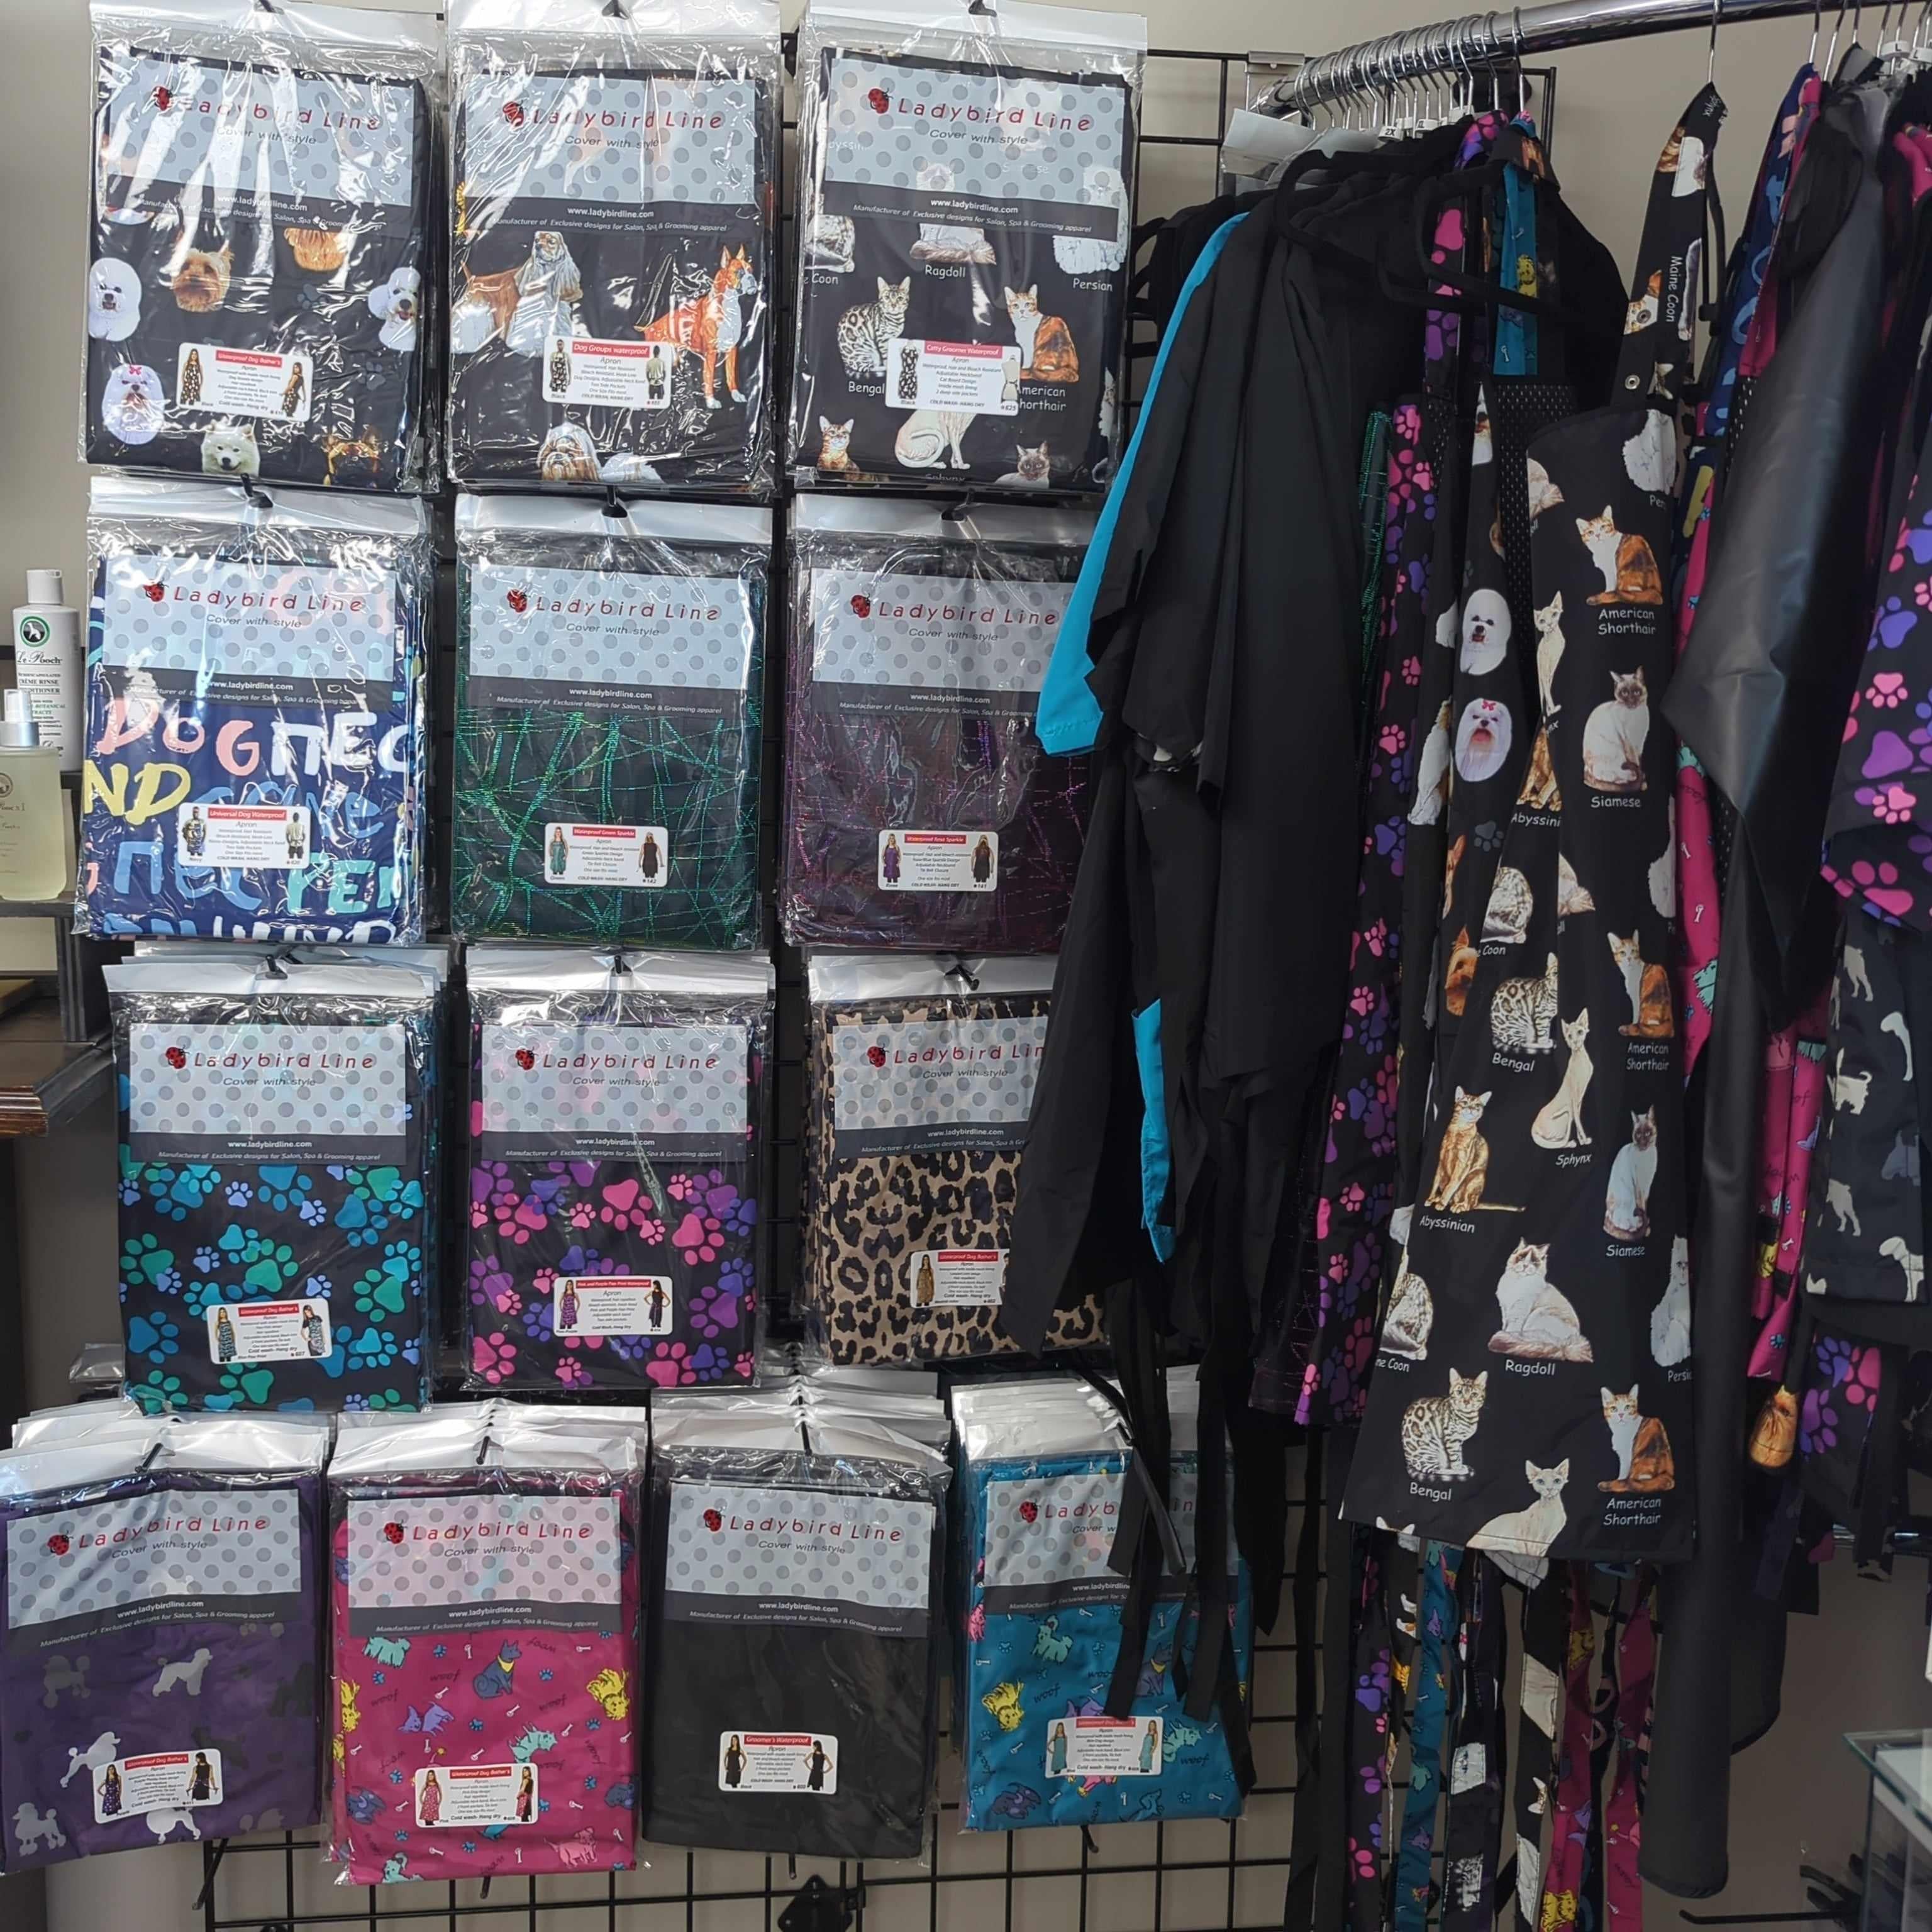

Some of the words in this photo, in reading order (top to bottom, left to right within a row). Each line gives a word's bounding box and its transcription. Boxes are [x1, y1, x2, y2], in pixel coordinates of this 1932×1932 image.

[1913, 50, 1918, 58] L
[324, 113, 379, 130] Line
[666, 111, 723, 128] Line
[899, 98, 1024, 123] Ladybird
[1035, 111, 1091, 131] Line
[216, 126, 253, 137] Cover
[287, 134, 316, 144] style
[930, 130, 967, 140] Cover
[971, 133, 995, 144] with
[1000, 136, 1028, 146] style
[565, 135, 601, 145] Cover
[607, 138, 631, 147] with
[636, 138, 659, 150] style
[567, 207, 654, 218] www.ladybirdline.com
[931, 198, 1019, 214] www.ladybirdline.com
[853, 204, 901, 216] Manufacturer
[913, 210, 945, 219] Exclusive
[946, 213, 973, 223] designs
[975, 215, 985, 223] for
[986, 218, 1007, 226] Salon,
[1009, 219, 1021, 227] Spa
[1031, 220, 1063, 232] Grooming
[1065, 224, 1092, 233] apparel
[925, 265, 966, 277] Ragdoll
[1670, 255, 1684, 293] Maine
[811, 274, 838, 285] Coon
[1073, 278, 1113, 291] Persian
[1666, 293, 1679, 323] Coon
[574, 344, 587, 352] Dog
[589, 345, 612, 353] Groups
[848, 381, 884, 397] Bengal
[1018, 385, 1066, 397] merican
[1020, 399, 1067, 412] horthair
[174, 587, 297, 609] Ladybird
[308, 597, 363, 612] Line
[536, 596, 655, 617] Ladybird
[665, 604, 719, 620] Line
[879, 602, 995, 623] Ladybird
[1005, 609, 1058, 625] Line
[1599, 608, 1655, 621] American
[207, 614, 241, 625] Cover
[246, 617, 269, 626] with
[274, 619, 302, 629] style
[567, 623, 600, 633] Cover
[606, 625, 628, 634] with
[633, 628, 660, 637] style
[909, 628, 942, 638] Cover
[947, 631, 968, 640] with
[972, 633, 999, 641] style
[1597, 622, 1657, 636] Shorthair
[569, 688, 653, 699] www.ladybirdline.com
[910, 693, 991, 704] www.ladybirdline.com
[1591, 796, 1641, 809] Siamese
[1511, 812, 1562, 827] Abyssini
[1482, 945, 1506, 956] Coon
[894, 1045, 1002, 1063] Ladybird
[1012, 1043, 1046, 1058] Lin
[1627, 1043, 1669, 1055] American
[195, 1053, 311, 1068] Ladybird
[321, 1054, 374, 1069] Line
[543, 1054, 655, 1069] Ladybird
[666, 1055, 717, 1070] Line
[1492, 1052, 1535, 1072] Bengal
[1626, 1059, 1670, 1070] Shorthair
[923, 1070, 953, 1079] Cover
[983, 1069, 1008, 1077] style
[264, 1078, 286, 1086] with
[290, 1078, 316, 1087] style
[573, 1077, 605, 1085] Cover
[609, 1077, 631, 1085] with
[635, 1077, 660, 1087] style
[928, 1128, 1004, 1137] www.ladybirdline.com
[228, 1140, 312, 1148] www.ladybirdline.com
[575, 1138, 655, 1146] www.ladybirdline.com
[1555, 1153, 1592, 1167] Sphynx
[1419, 1215, 1475, 1233] Abyssinian
[1606, 1245, 1645, 1257] Siamese
[1387, 1358, 1409, 1372] Coon
[1505, 1359, 1555, 1376] Ragdoll
[1668, 1368, 1691, 1382] Persi
[1409, 1482, 1452, 1501] Bengal
[1046, 1501, 1116, 1518] Ladyb
[1606, 1496, 1661, 1509] American
[1602, 1513, 1661, 1525] Shorthair
[79, 1518, 203, 1549] Ladybird
[213, 1518, 267, 1532] Line
[413, 1523, 528, 1540] Ladybird
[539, 1524, 593, 1539] Line
[730, 1516, 842, 1536] Ladybird
[852, 1525, 902, 1541] Line
[1072, 1525, 1104, 1534] Cover
[112, 1545, 147, 1558] Cover
[152, 1540, 176, 1548] with
[180, 1540, 208, 1550] style
[444, 1547, 479, 1557] Cover
[484, 1546, 505, 1555] with
[511, 1546, 535, 1555] style
[758, 1540, 792, 1549] Cover
[796, 1543, 817, 1552] with
[822, 1545, 845, 1554] style
[117, 1600, 204, 1619] www.ladybirdline.com
[448, 1606, 531, 1618] www.ladybirdline.com
[758, 1602, 838, 1613] www.ladybirdline.com
[40, 1633, 88, 1647] Manufacturer
[100, 1622, 132, 1633] Exclusive
[134, 1615, 160, 1626] designs
[216, 1611, 248, 1619] Grooming
